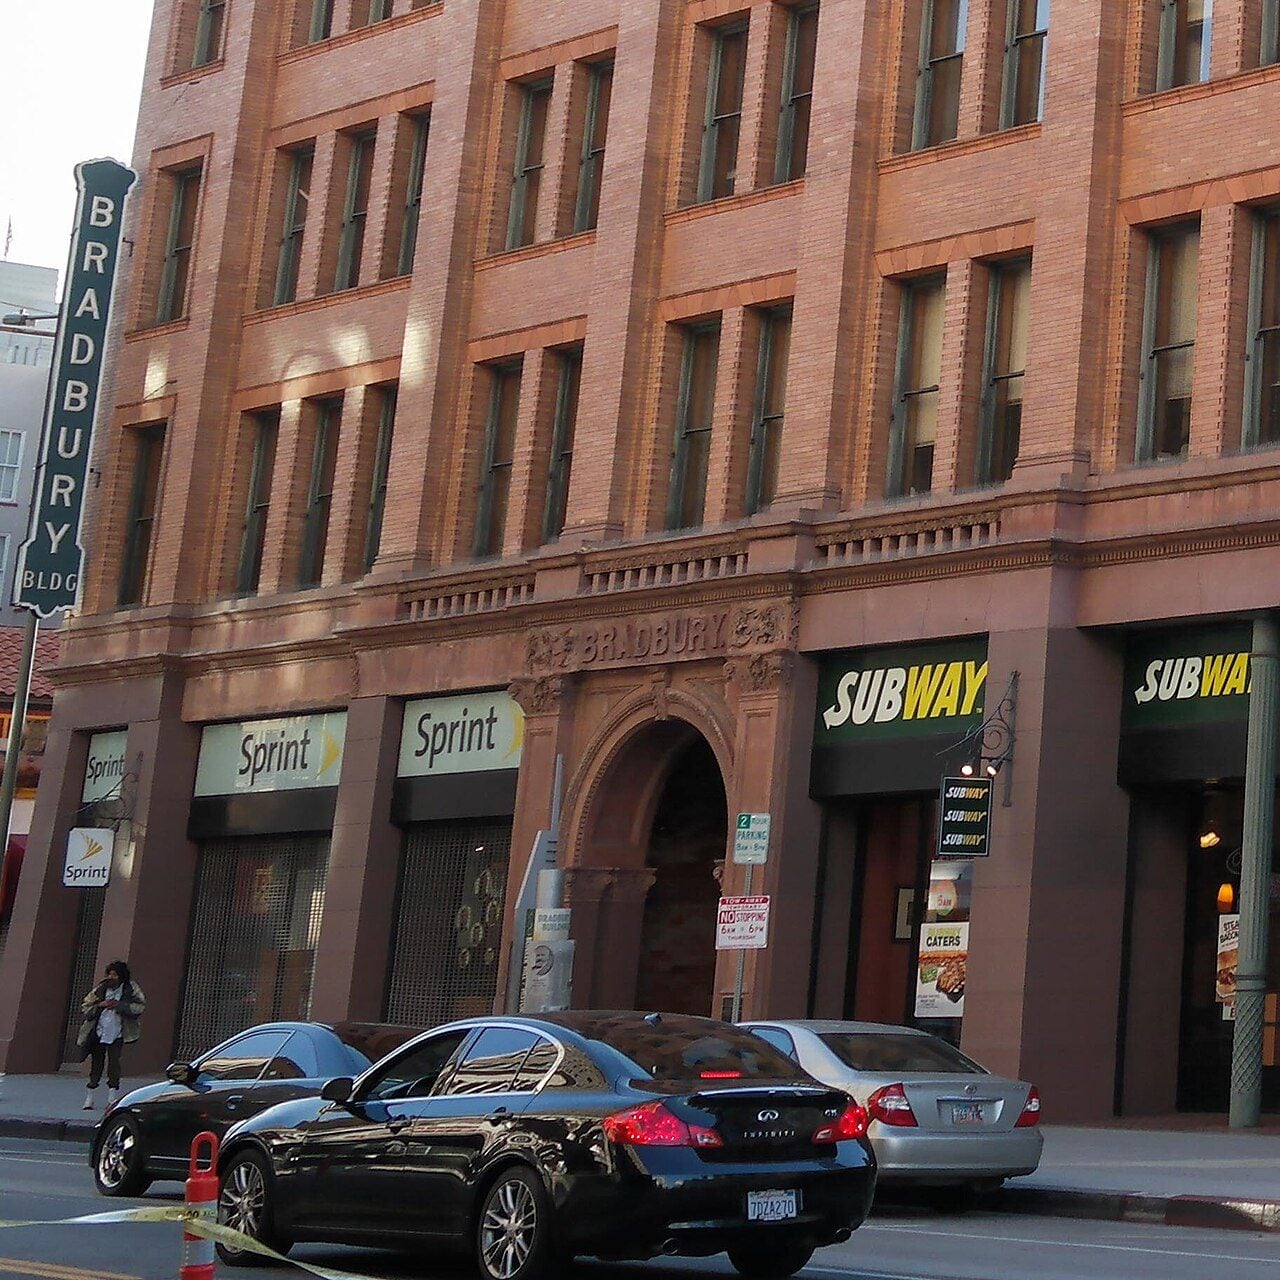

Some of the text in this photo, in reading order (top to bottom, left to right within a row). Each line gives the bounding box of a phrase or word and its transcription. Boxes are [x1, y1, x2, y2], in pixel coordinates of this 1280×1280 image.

[45, 195, 115, 555] BRADBURY
[22, 569, 78, 593] BLDG
[1134, 652, 1251, 704] SUBWA
[823, 660, 989, 730] SUBWAY
[414, 707, 498, 768] Sprint
[238, 727, 311, 786] Sprint
[87, 753, 124, 784] Sprint
[945, 786, 988, 799] SUBWAY
[740, 817, 747, 827] 2
[944, 809, 987, 823] SUBWAY
[737, 831, 767, 840] PARKING
[942, 833, 985, 846] SUBWAY
[65, 864, 108, 882] Sprint
[720, 911, 766, 923] NO STOPPING
[721, 925, 736, 934] 6AM
[748, 925, 764, 933] 6PM
[926, 936, 961, 947] CATERS
[744, 1130, 795, 1138] INFINITI
[750, 1200, 793, 1215] 7DZA270
